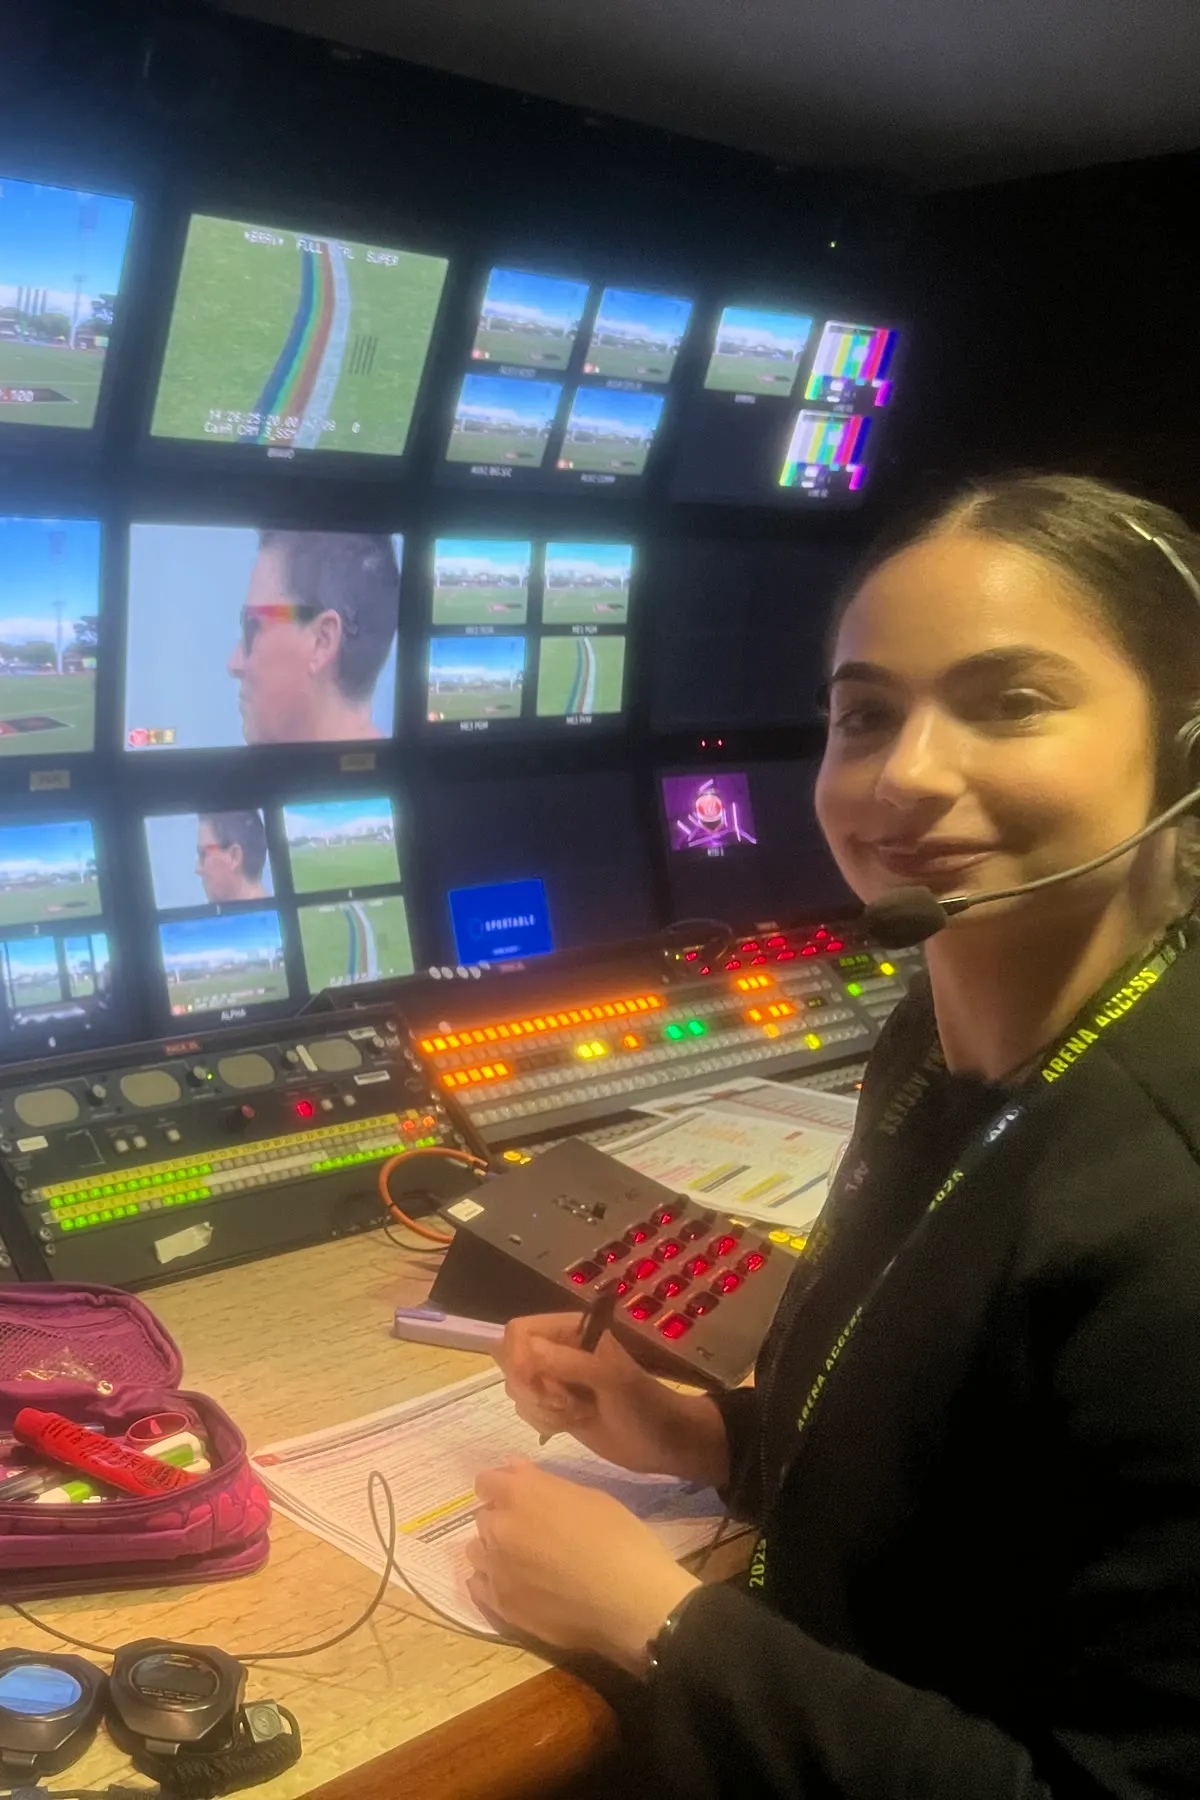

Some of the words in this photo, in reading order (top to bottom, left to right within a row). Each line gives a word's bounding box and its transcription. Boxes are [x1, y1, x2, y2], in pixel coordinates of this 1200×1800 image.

[296, 238, 323, 255] FULL
[484, 914, 535, 933] SPORTABLE
[220, 1008, 247, 1022] ALPHA
[1041, 1027, 1099, 1084] ARENA
[1094, 967, 1159, 1028] ACCESS
